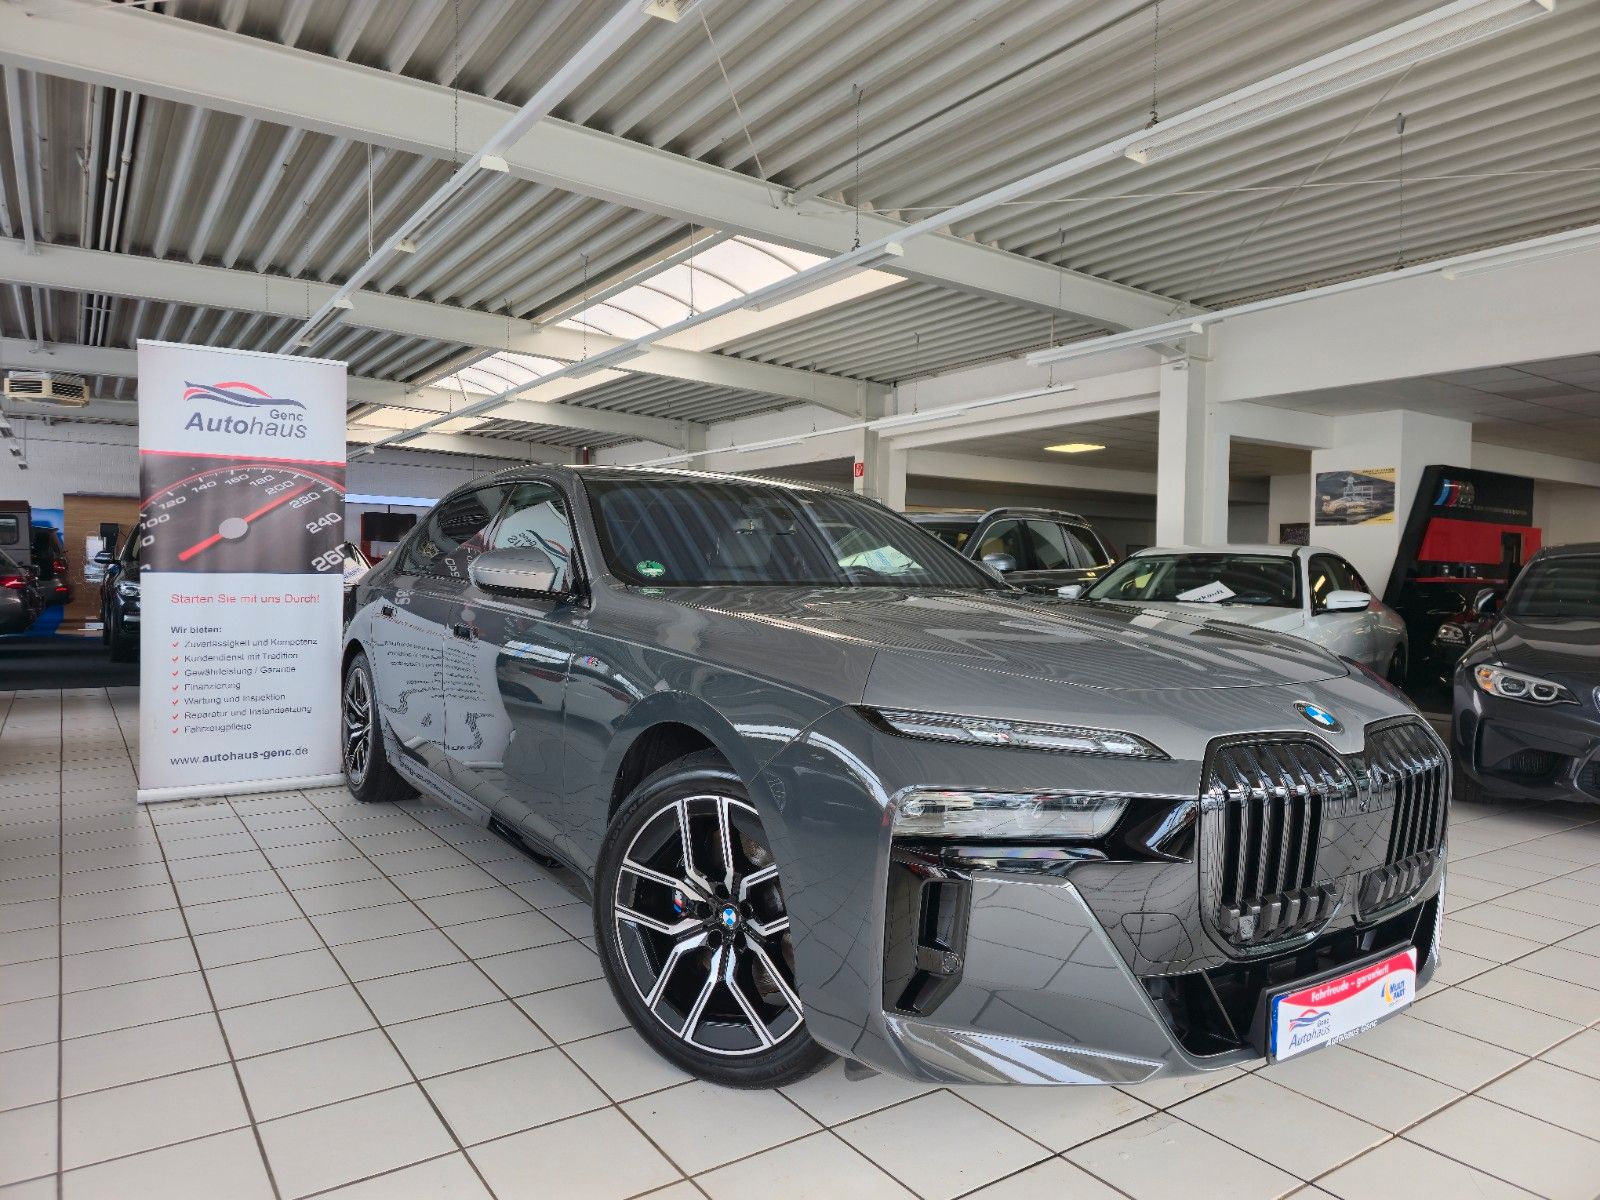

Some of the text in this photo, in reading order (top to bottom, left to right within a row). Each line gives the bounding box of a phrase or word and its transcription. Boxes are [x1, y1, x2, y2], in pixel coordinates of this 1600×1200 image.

[270, 408, 304, 422] Genc
[184, 411, 308, 439] Autohaus
[224, 474, 250, 486] 160
[249, 474, 275, 487] 180
[191, 481, 217, 493] 140
[264, 480, 295, 495] 200
[158, 496, 187, 510] 120
[288, 492, 321, 509] 220
[305, 512, 343, 534] 240
[140, 535, 156, 548] 0
[171, 593, 320, 605] Starten Sie mit uns Durch!
[170, 626, 222, 635] Wir bieten:
[252, 639, 268, 647] und
[270, 638, 318, 648] Kompetenz
[184, 652, 299, 663] Kundendienst mit Tradition
[184, 667, 253, 677] Gewährleistung
[260, 665, 296, 674] Garantie
[184, 681, 241, 691] Finanzierung
[184, 693, 286, 706] Wartung und Inspektion
[184, 705, 313, 721] Reparatur und Instandsetzung
[184, 722, 252, 735] Fahrzeugpflege
[170, 746, 309, 766] www.autohaus-genc.de
[1288, 1024, 1331, 1050] Autohaus
